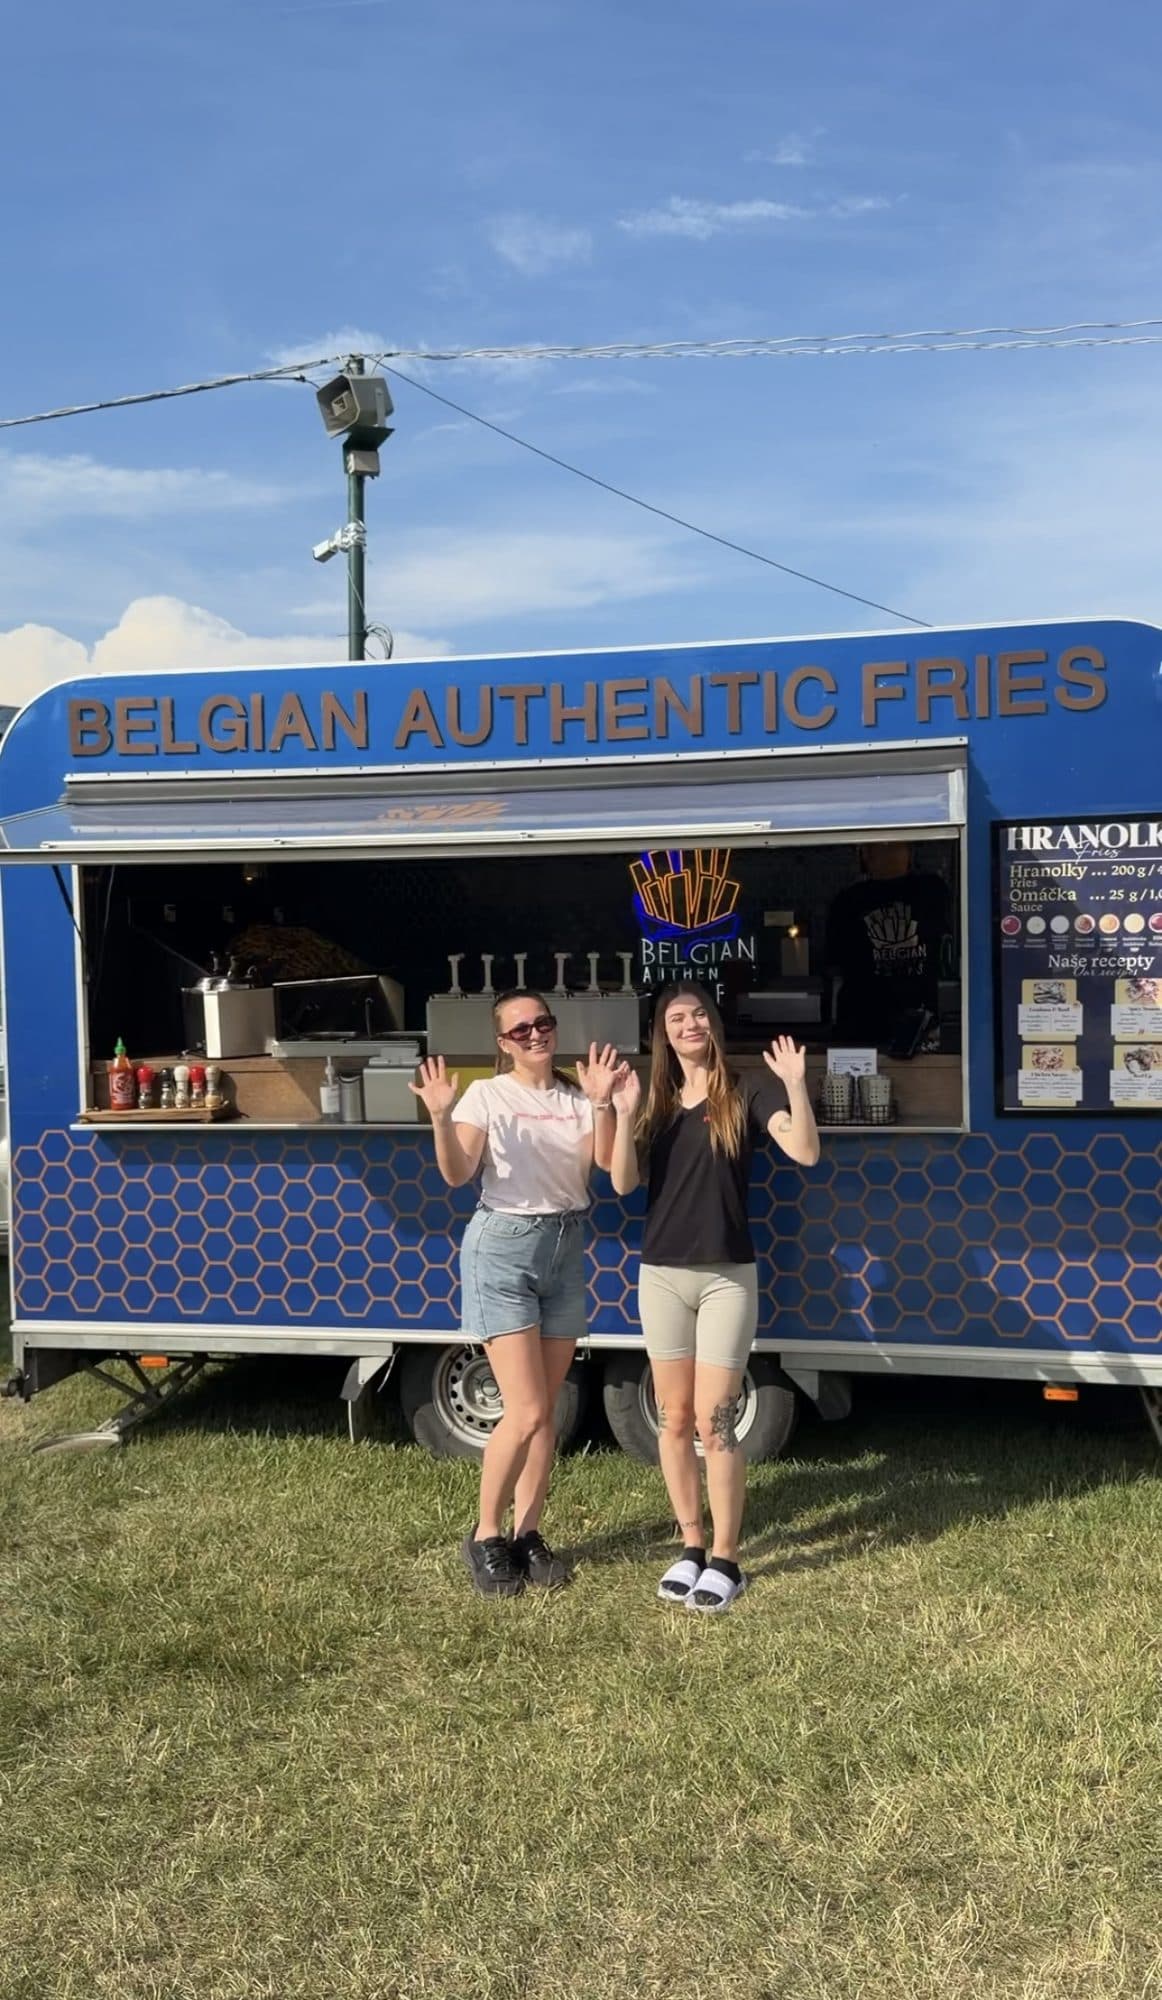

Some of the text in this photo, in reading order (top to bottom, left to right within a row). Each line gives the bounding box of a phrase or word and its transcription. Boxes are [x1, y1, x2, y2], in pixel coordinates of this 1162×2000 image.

[68, 646, 1109, 757] BELGIAN AUTHENTIC FRIES
[1010, 863, 1088, 880] Hranolky
[1111, 865, 1135, 876] 200
[1137, 866, 1146, 878] g
[1010, 878, 1037, 888] Fries
[1009, 887, 1077, 902] Omáčka
[1109, 889, 1125, 900] 25
[1129, 891, 1138, 902] g
[1010, 902, 1043, 912] Sauce
[641, 936, 755, 965] BELGIAN
[1048, 953, 1155, 970] Naše recepty
